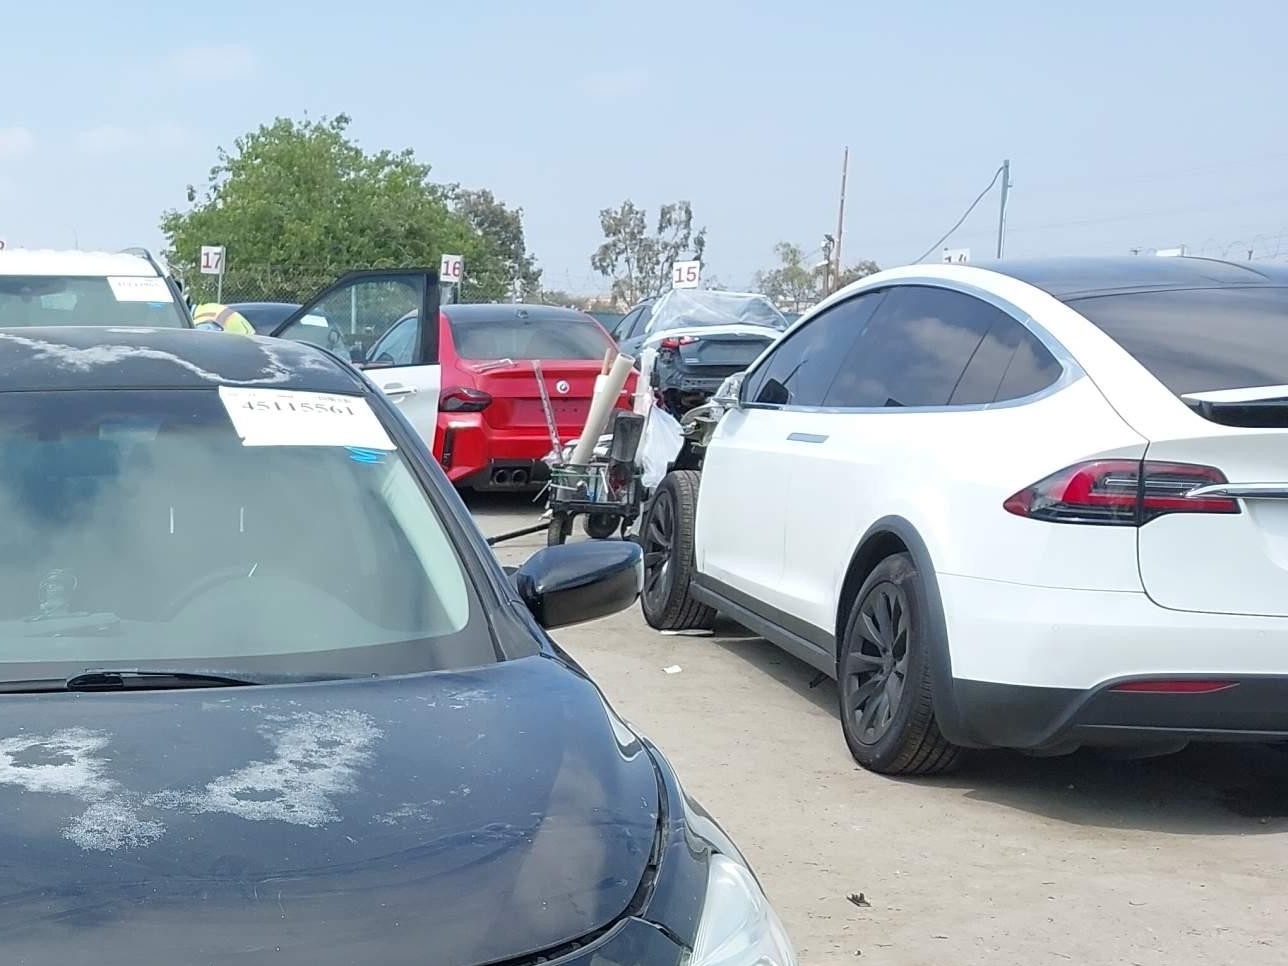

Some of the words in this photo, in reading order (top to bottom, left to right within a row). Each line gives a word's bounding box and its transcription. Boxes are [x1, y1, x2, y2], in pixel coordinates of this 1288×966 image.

[202, 252, 223, 270] 17
[443, 261, 462, 277] 16
[674, 266, 698, 283] 15
